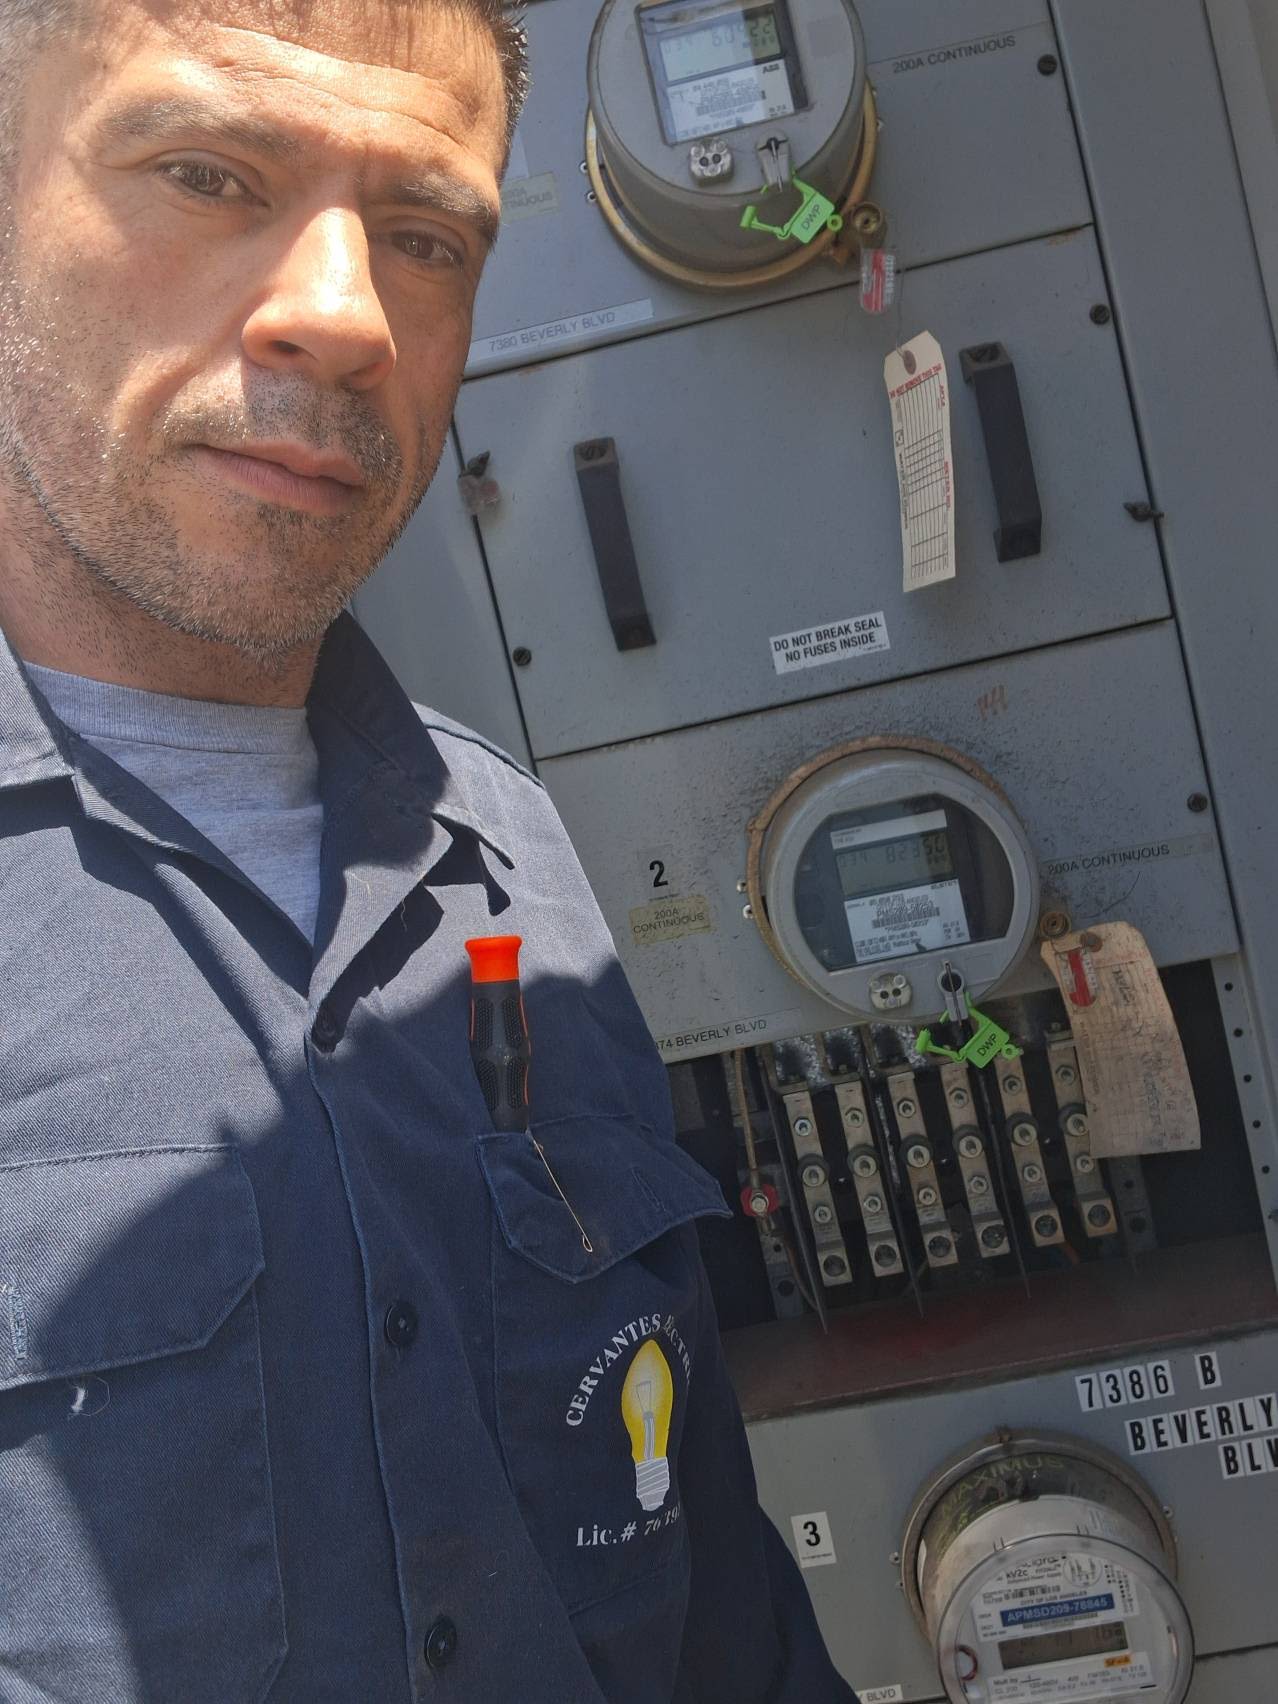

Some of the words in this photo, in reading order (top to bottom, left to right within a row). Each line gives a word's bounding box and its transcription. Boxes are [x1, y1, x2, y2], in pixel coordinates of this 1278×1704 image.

[893, 58, 925, 73] 200A
[927, 35, 1016, 65] CONTINUOUS
[801, 203, 821, 231] DWP
[521, 320, 577, 344] BEVERLY
[583, 312, 615, 329] BLVD
[773, 639, 789, 652] DO
[792, 632, 813, 648] NOT
[815, 624, 852, 642] BREAK
[854, 617, 882, 632] SEAL
[785, 650, 801, 663] NO
[803, 641, 837, 659] FUSES
[839, 632, 876, 650] INSIDE
[649, 860, 669, 888] 2
[1048, 862, 1079, 876] 200A
[1082, 844, 1170, 870] CONTINUOUS
[633, 912, 705, 934] CONTINUOUS
[654, 907, 679, 921] 200A
[676, 1027, 731, 1047] BEVERLY
[735, 1019, 767, 1035] BLVD
[976, 1033, 997, 1057] DWP
[566, 1313, 661, 1427] CERVANTES
[1080, 1363, 1169, 1408] 7386
[1199, 1354, 1216, 1386] B
[1129, 1396, 1273, 1451] BEVERLY
[803, 1521, 821, 1547] 3
[866, 1688, 896, 1701] BLVD
